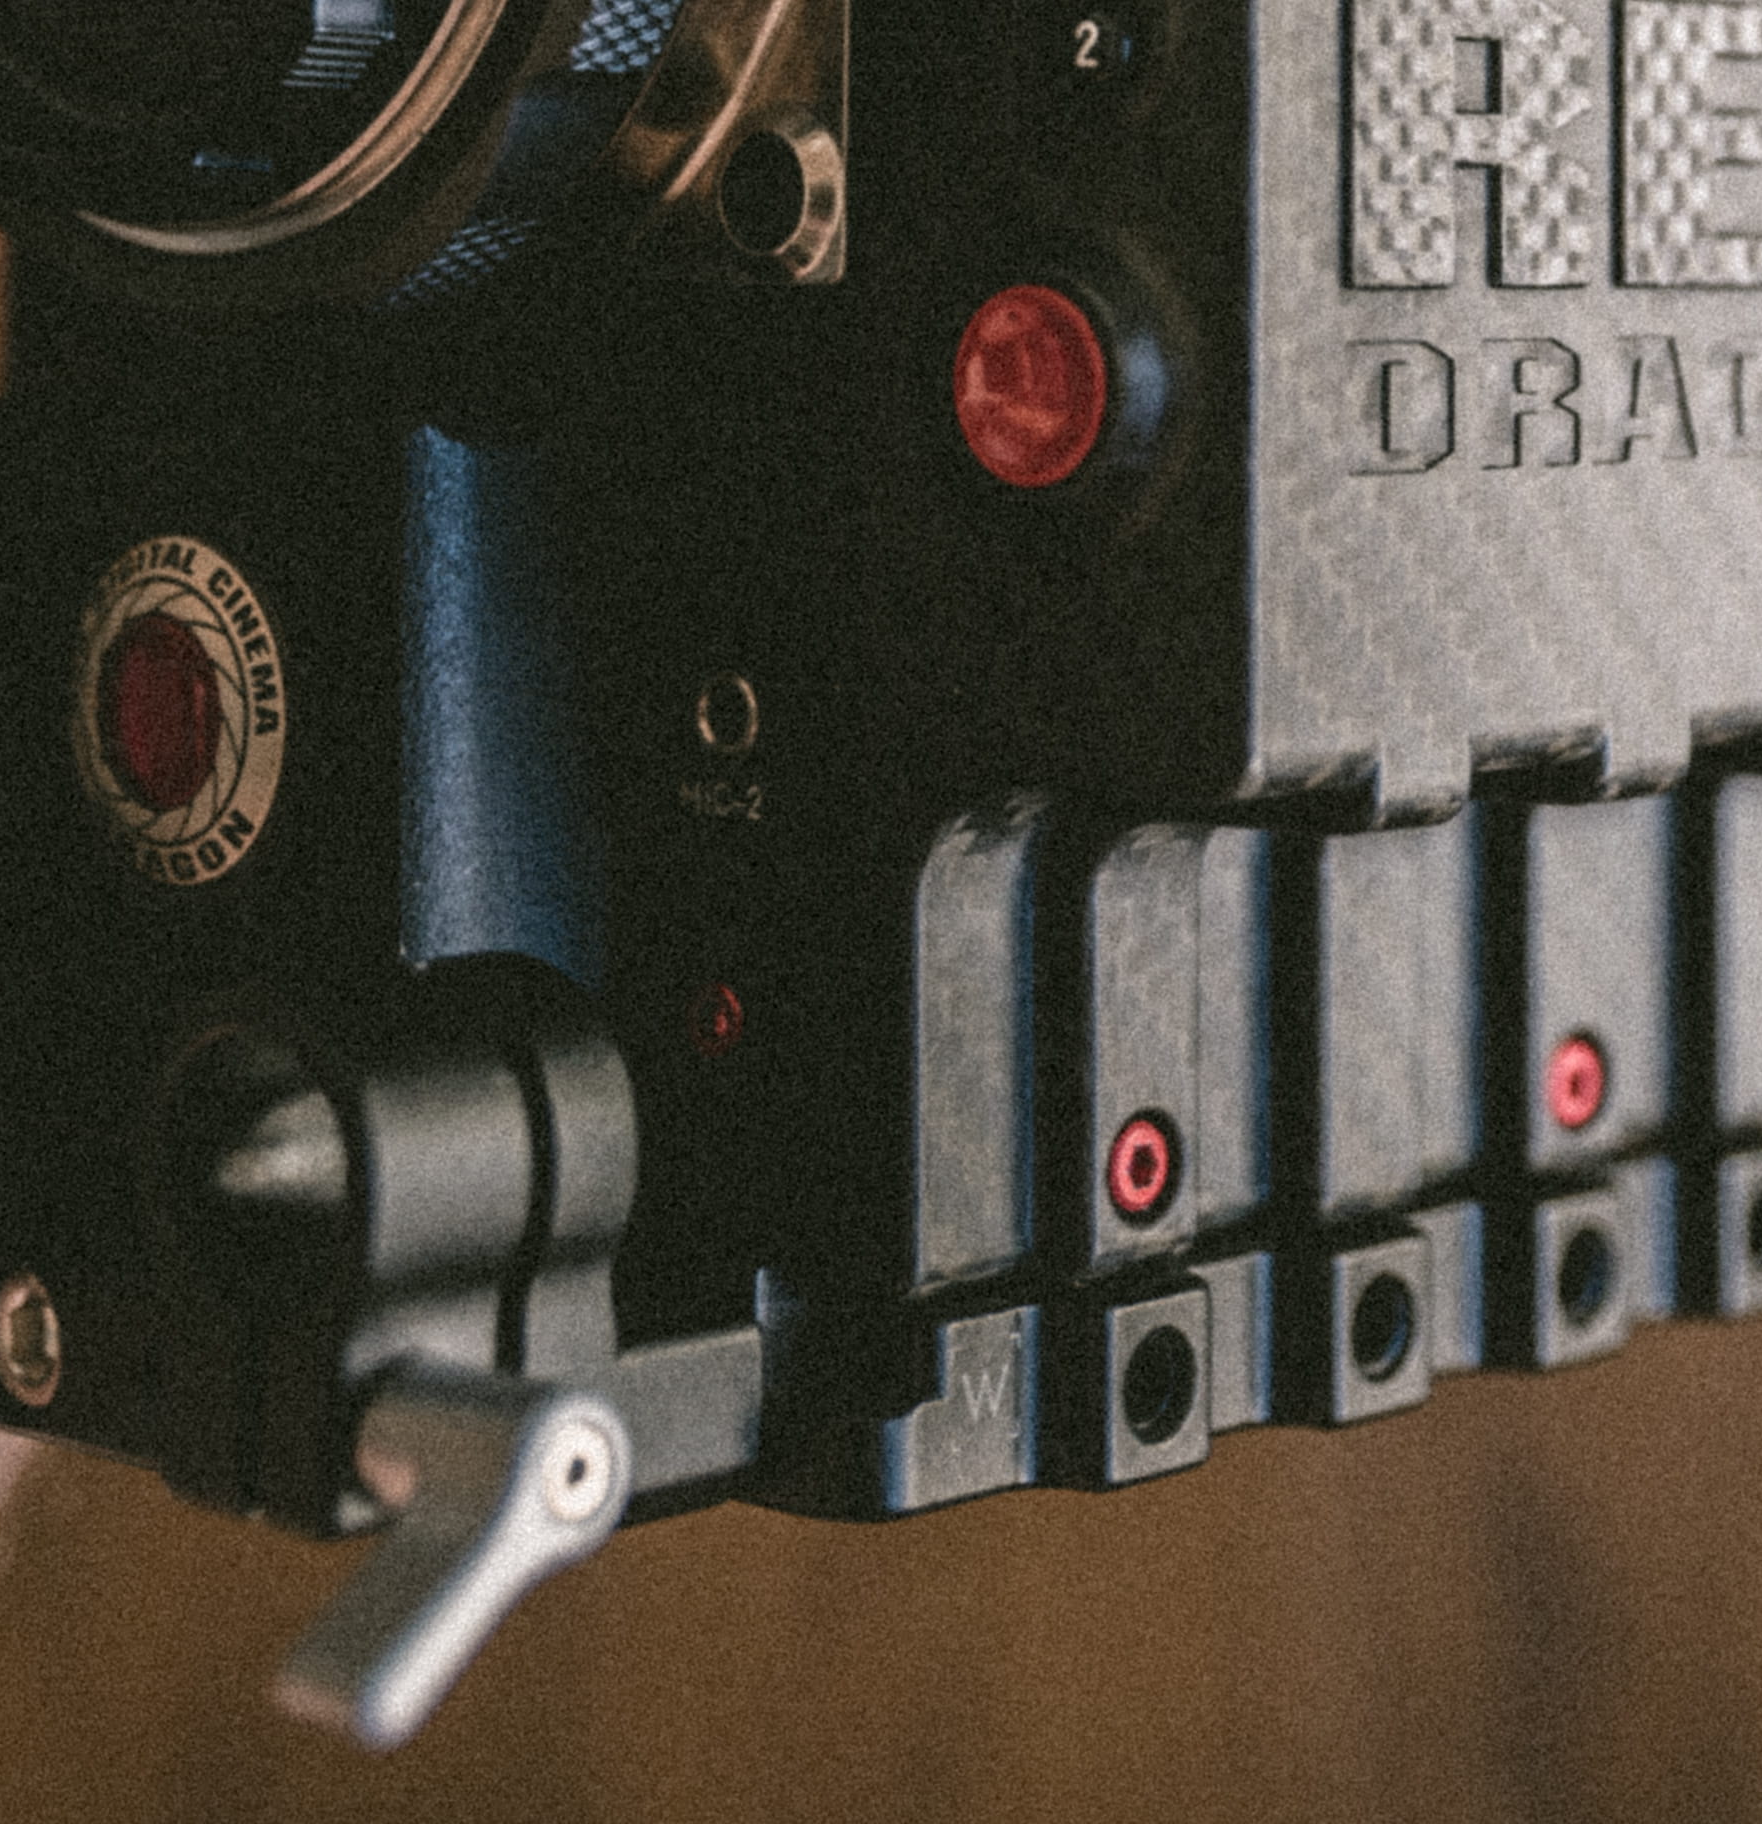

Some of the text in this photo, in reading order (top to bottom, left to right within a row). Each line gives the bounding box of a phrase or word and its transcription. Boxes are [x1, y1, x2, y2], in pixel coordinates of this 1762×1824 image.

[1074, 19, 1099, 68] 2
[206, 566, 279, 737] CINEMA
[137, 807, 255, 880] AGON
